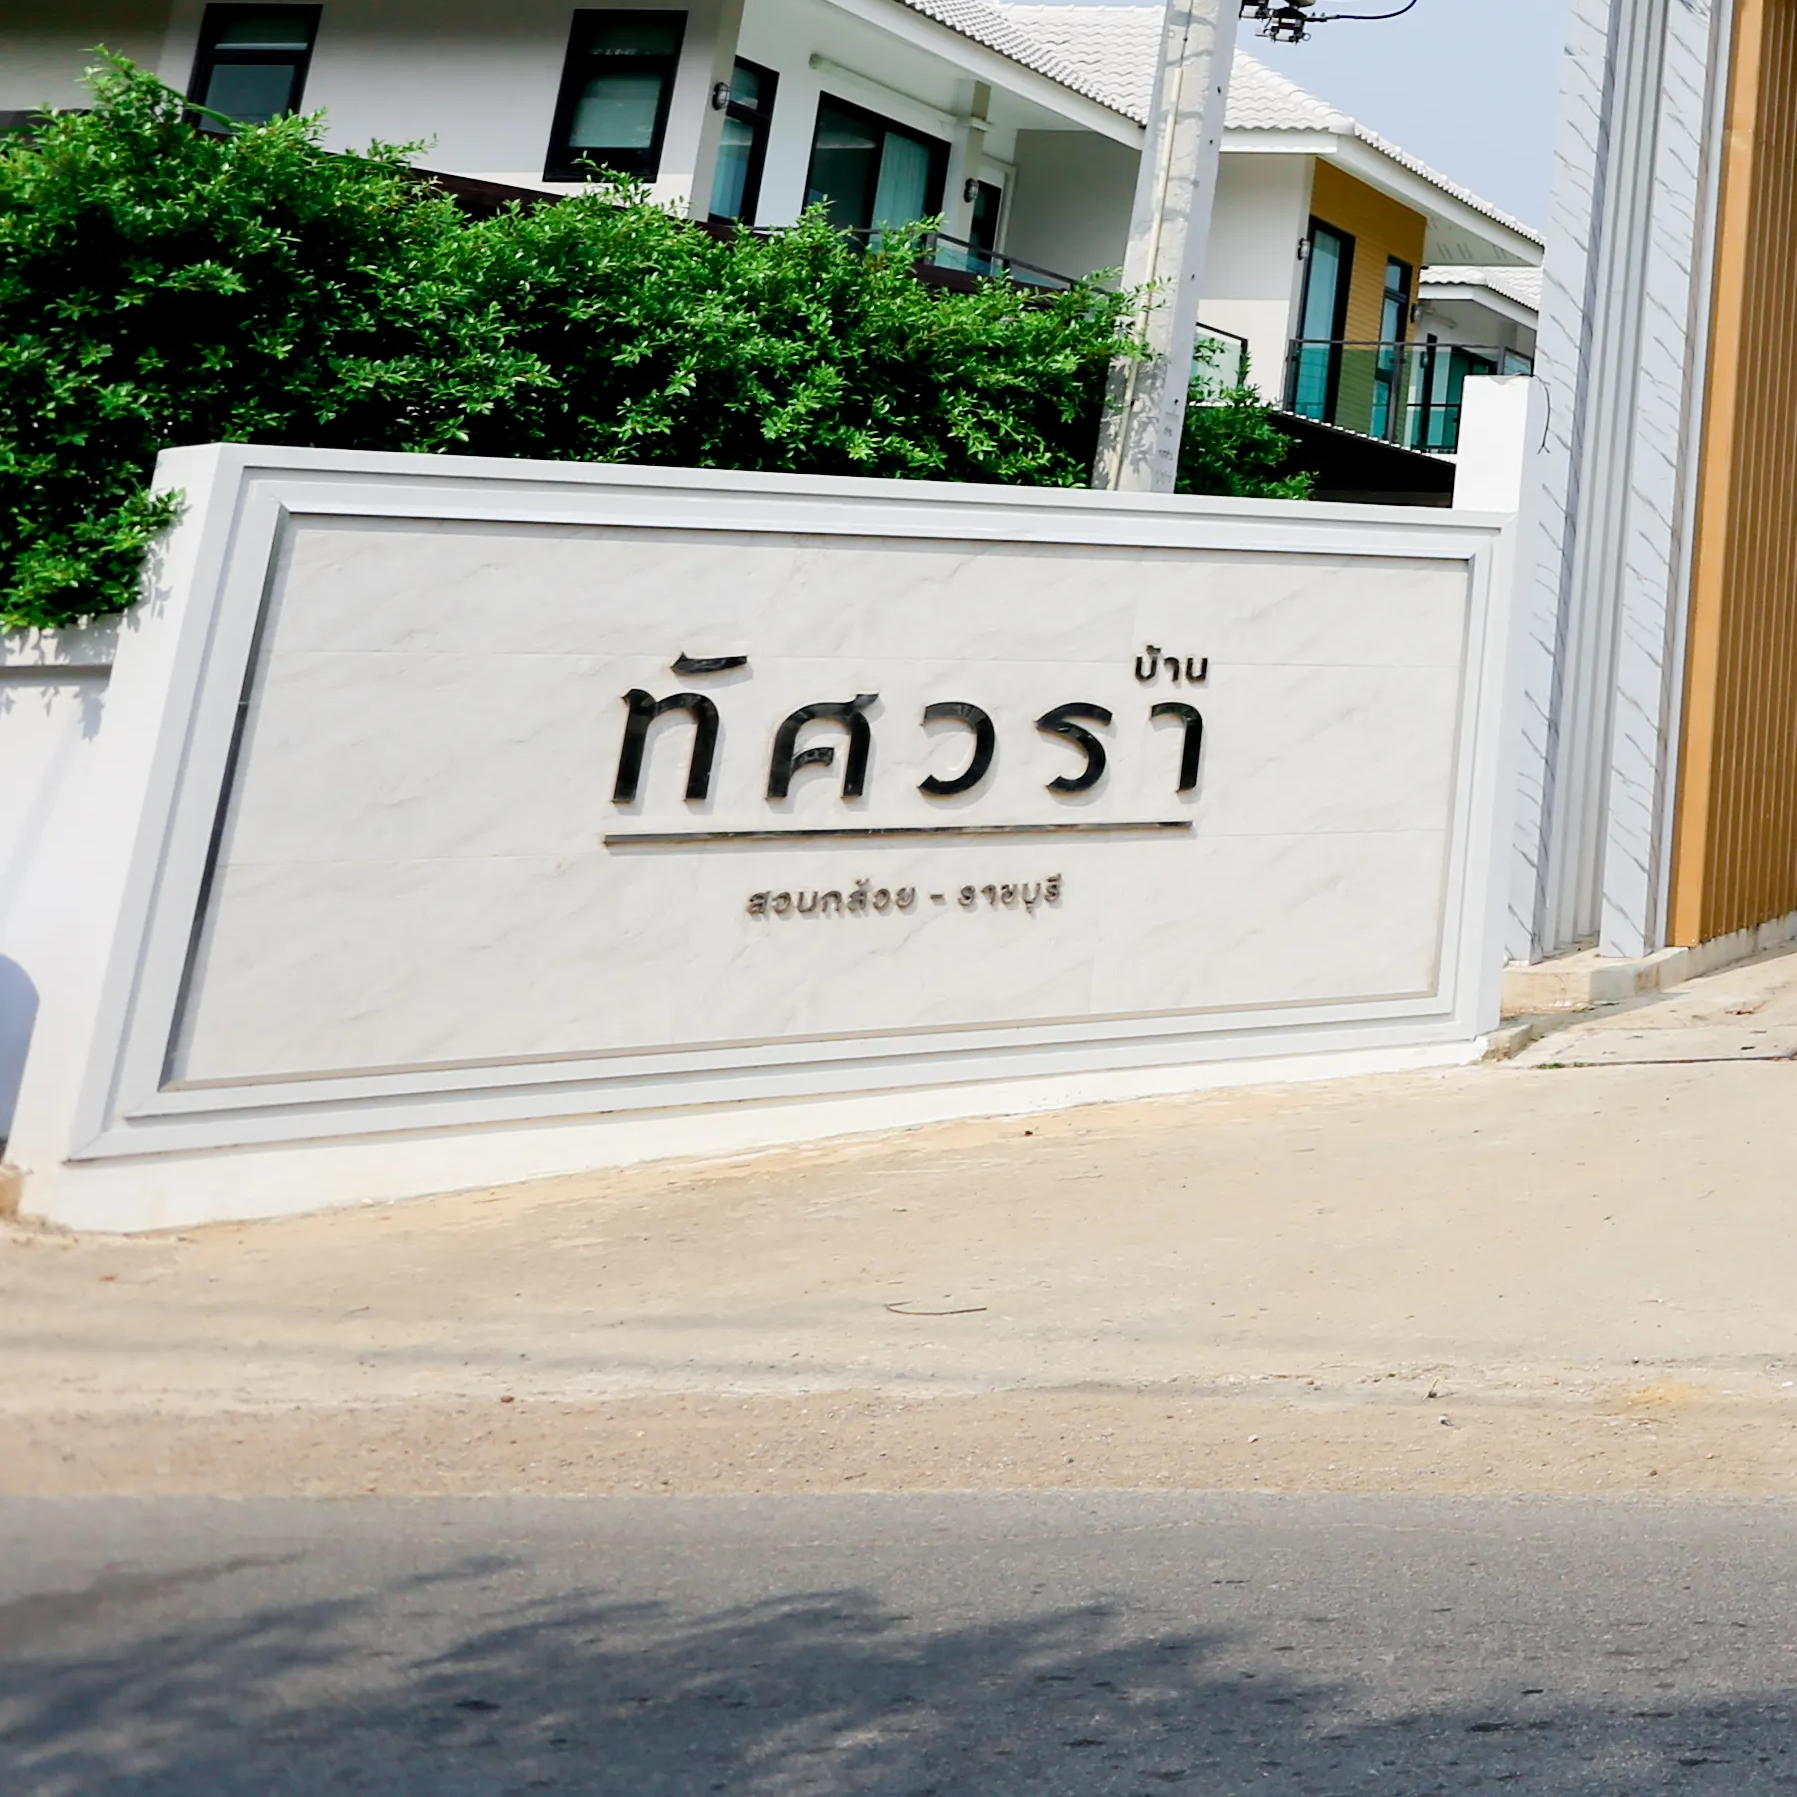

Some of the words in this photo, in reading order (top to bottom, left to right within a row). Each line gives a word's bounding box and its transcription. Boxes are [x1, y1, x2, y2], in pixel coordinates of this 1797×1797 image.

[1134, 644, 1208, 683] บ้าน
[746, 878, 916, 917] สวนกล้วย
[957, 873, 1062, 914] ราชบุรี
